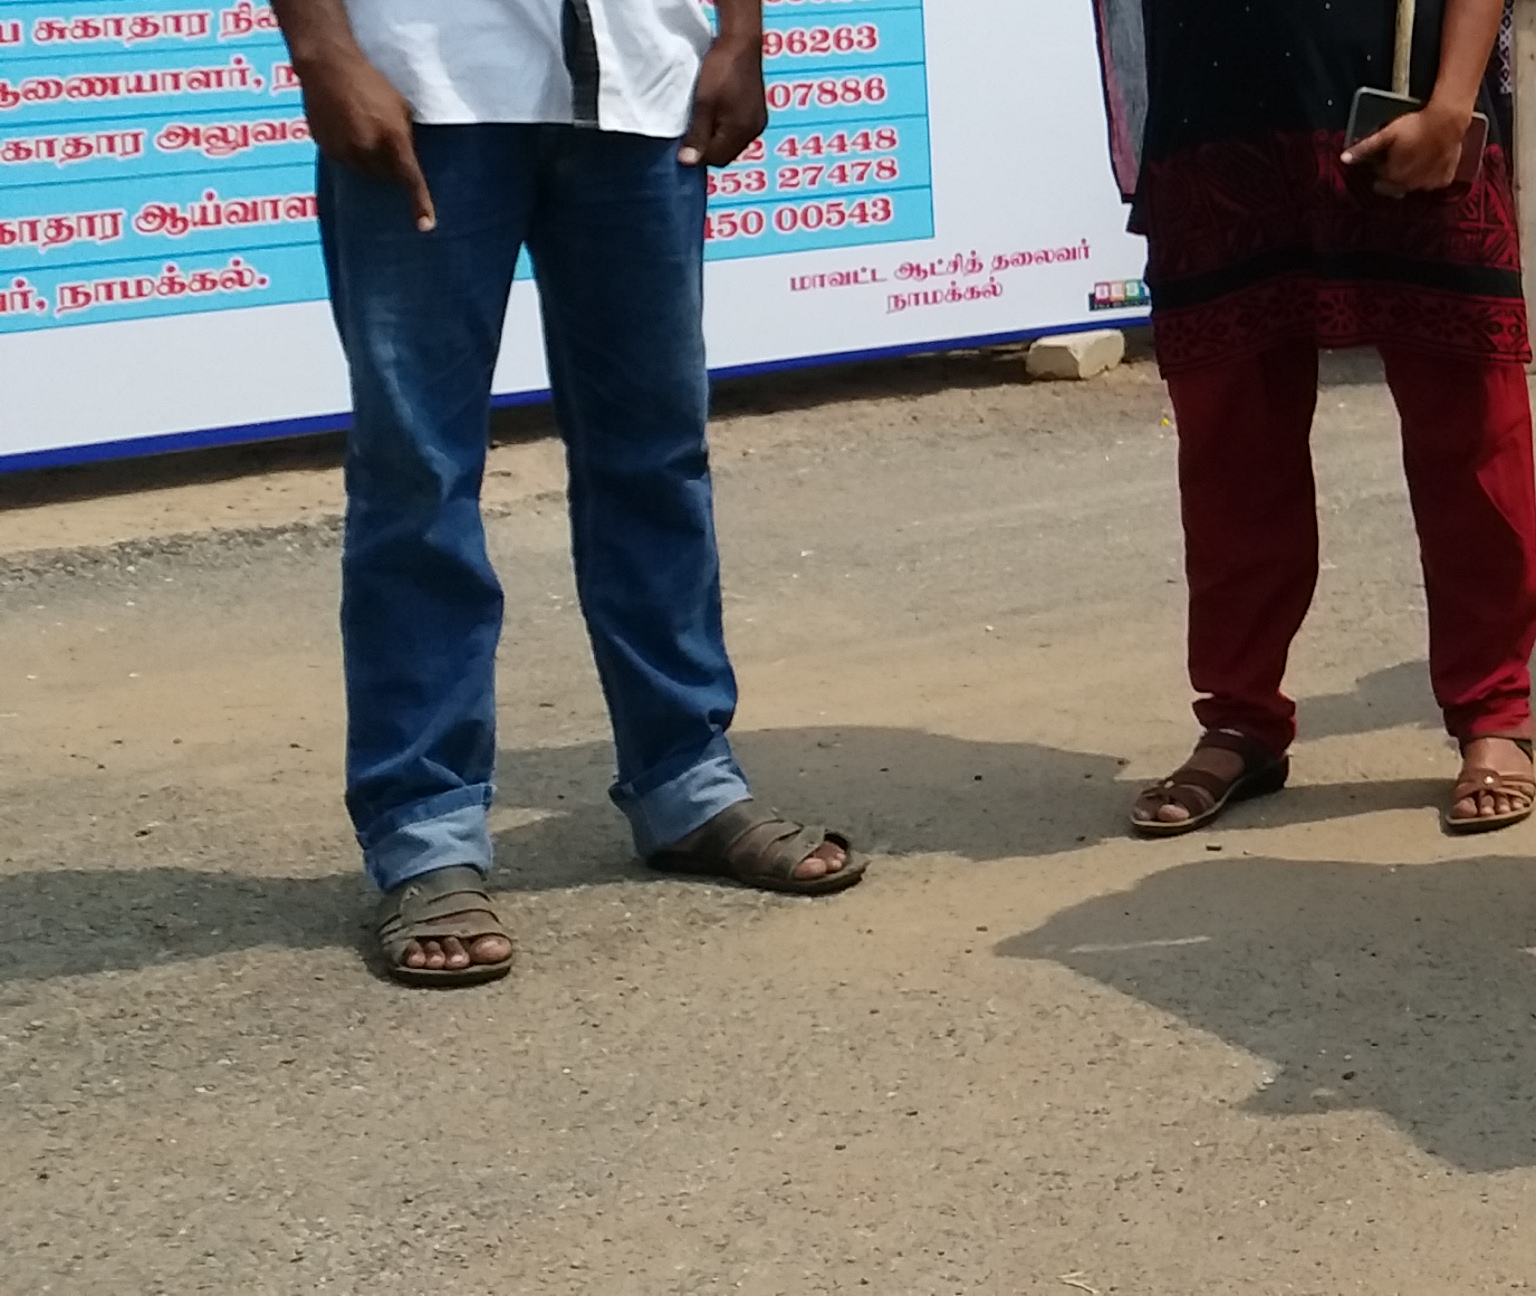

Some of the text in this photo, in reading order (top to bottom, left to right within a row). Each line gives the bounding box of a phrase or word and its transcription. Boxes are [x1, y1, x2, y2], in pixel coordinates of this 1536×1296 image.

[33, 11, 211, 45] சுகாதார
[762, 25, 878, 56] 96263
[767, 76, 886, 109] 07886
[0, 128, 143, 167] காதார
[776, 127, 898, 157] 44448
[778, 158, 898, 190] 27478
[775, 197, 893, 231] 00543
[790, 237, 1091, 291] மாவட்ட ஆட்சித் தலைவர்
[57, 259, 268, 314] நாமக்கல்.
[886, 281, 1003, 314] நாமக்கல்
